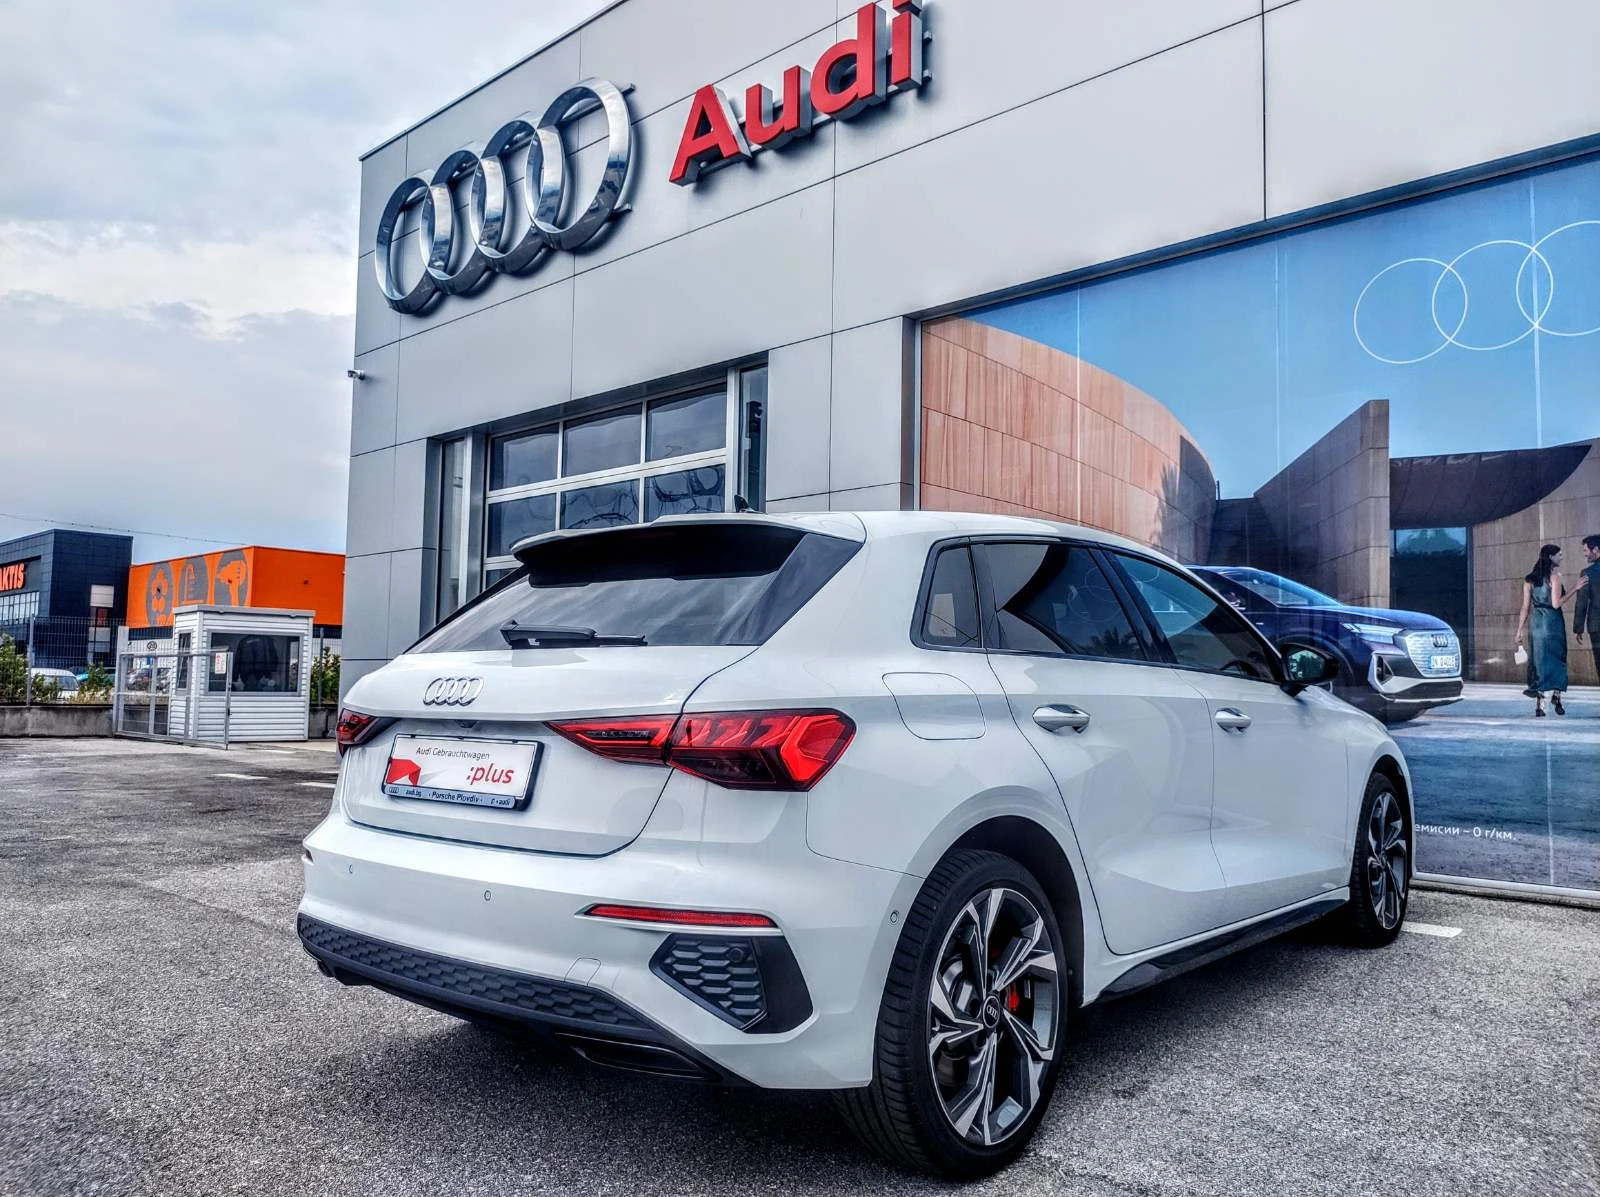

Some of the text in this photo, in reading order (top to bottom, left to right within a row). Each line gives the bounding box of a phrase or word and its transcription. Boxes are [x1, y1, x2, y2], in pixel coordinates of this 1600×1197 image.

[669, 0, 920, 185] Audi
[416, 746, 490, 761] Audi Gebrauchtwagen
[431, 790, 456, 801] Porsche
